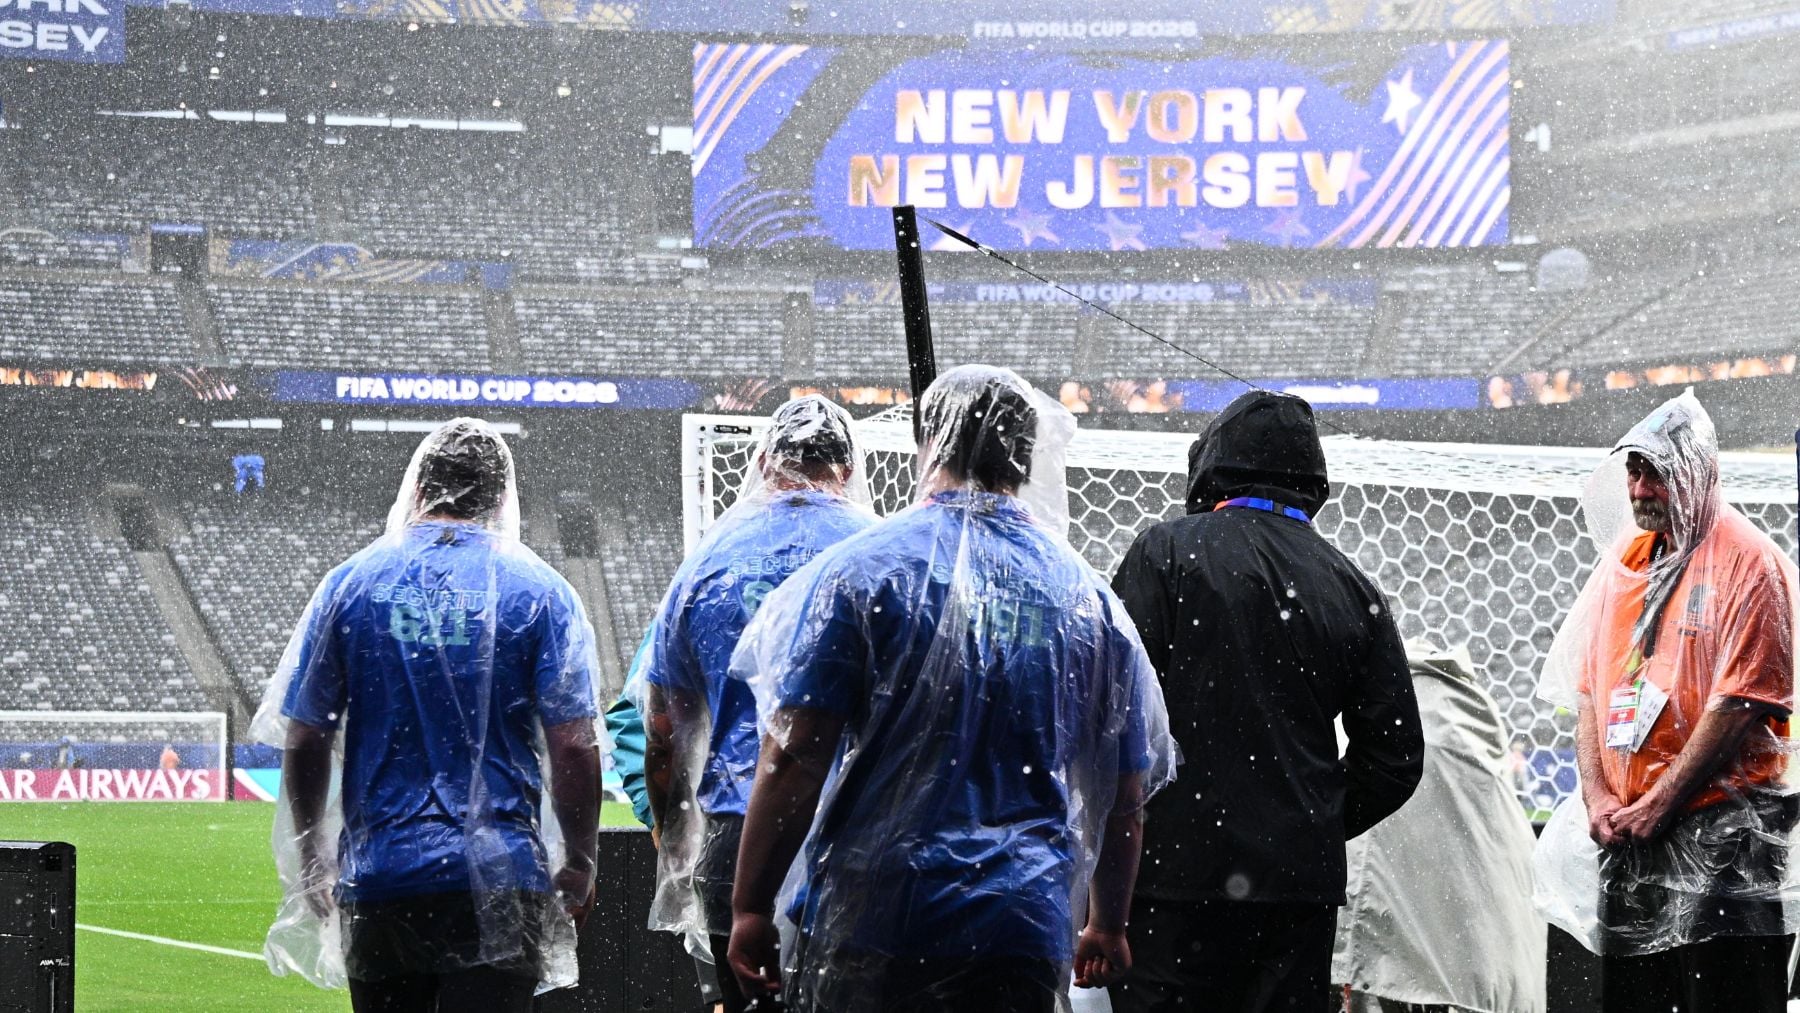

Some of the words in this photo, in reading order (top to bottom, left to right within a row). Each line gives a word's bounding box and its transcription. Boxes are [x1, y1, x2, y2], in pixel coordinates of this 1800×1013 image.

[974, 21, 1015, 38] FIFA
[1017, 21, 1087, 38] WORLD
[1089, 21, 1128, 38] CUP
[1130, 20, 1198, 38] 2026
[895, 88, 1071, 144] NEW
[1094, 86, 1309, 144] YORK
[848, 153, 1025, 208] NEW
[1045, 150, 1355, 209] JERSEY
[976, 284, 1019, 301] FIFA
[1021, 284, 1097, 301] WORLD
[1099, 284, 1140, 301] CUP
[336, 376, 390, 399] FIFA
[391, 377, 480, 401] WORLD
[481, 379, 531, 402] CUP
[532, 380, 619, 404] 2026
[51, 768, 213, 800] AIRWAYS
